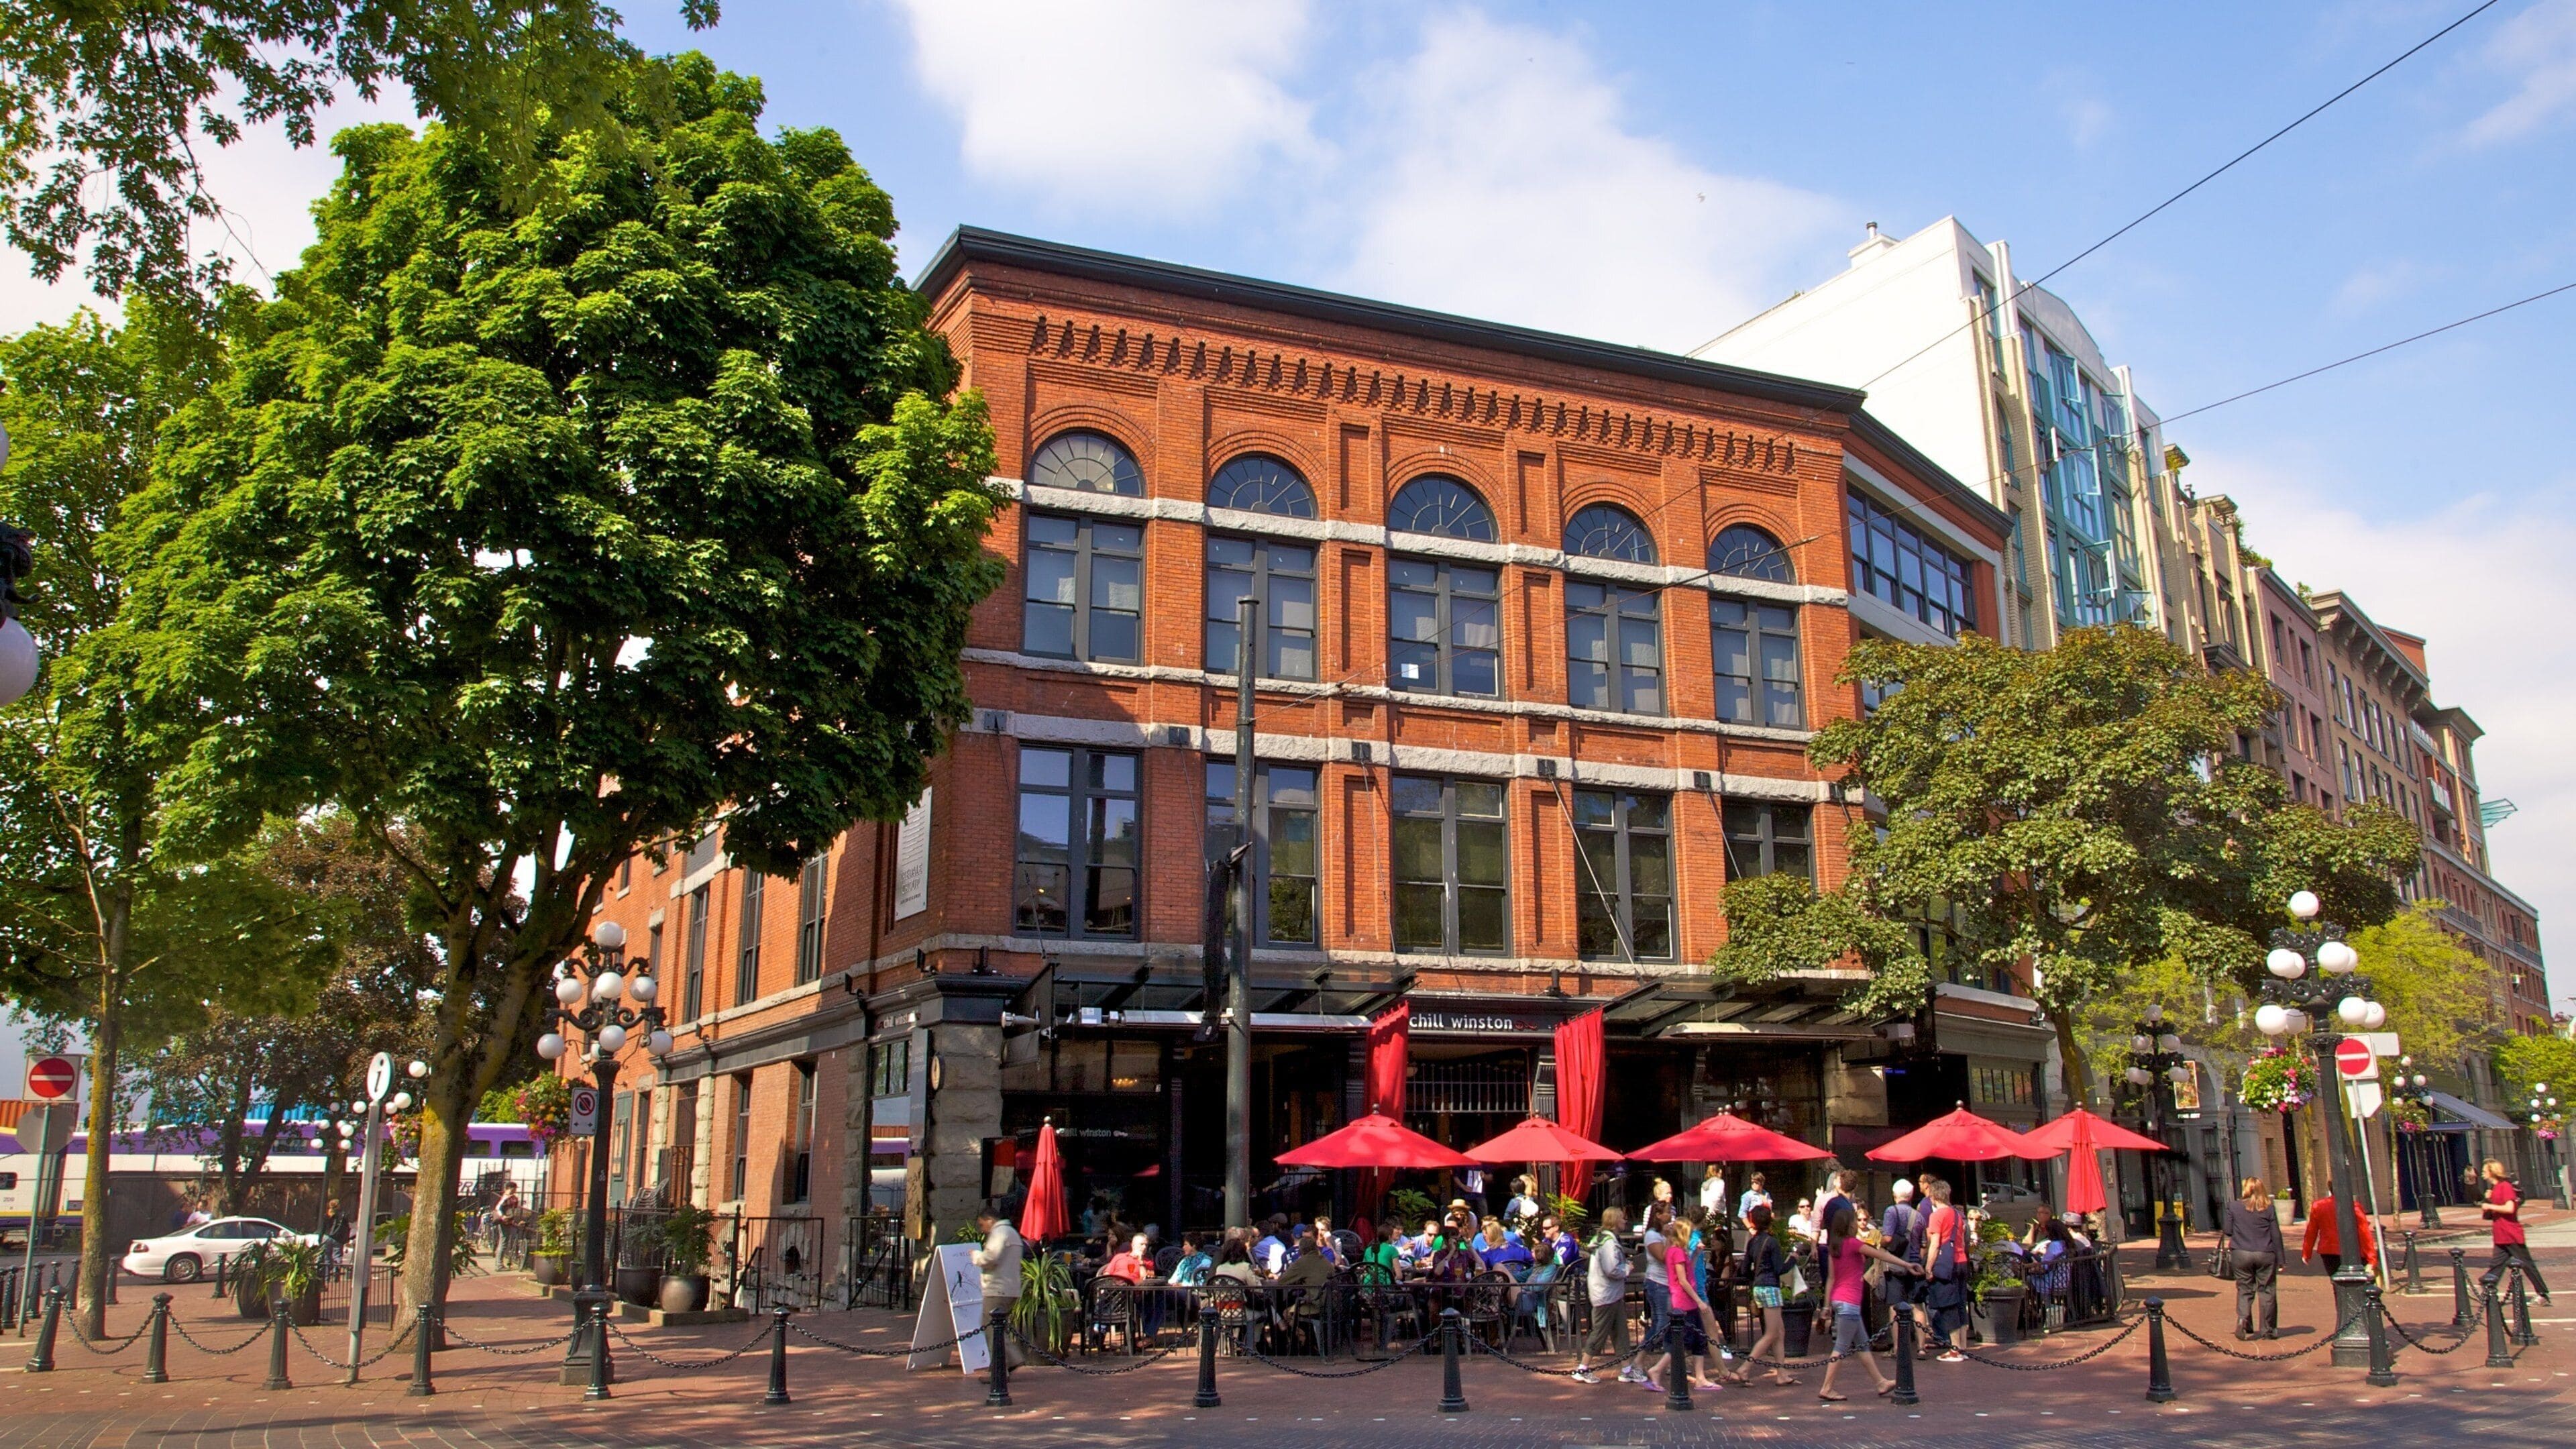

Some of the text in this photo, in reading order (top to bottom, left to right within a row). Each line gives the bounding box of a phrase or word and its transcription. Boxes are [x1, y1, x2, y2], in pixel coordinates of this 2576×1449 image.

[1409, 1013, 1513, 1030] chill winston
[1079, 1128, 1111, 1137] winston
